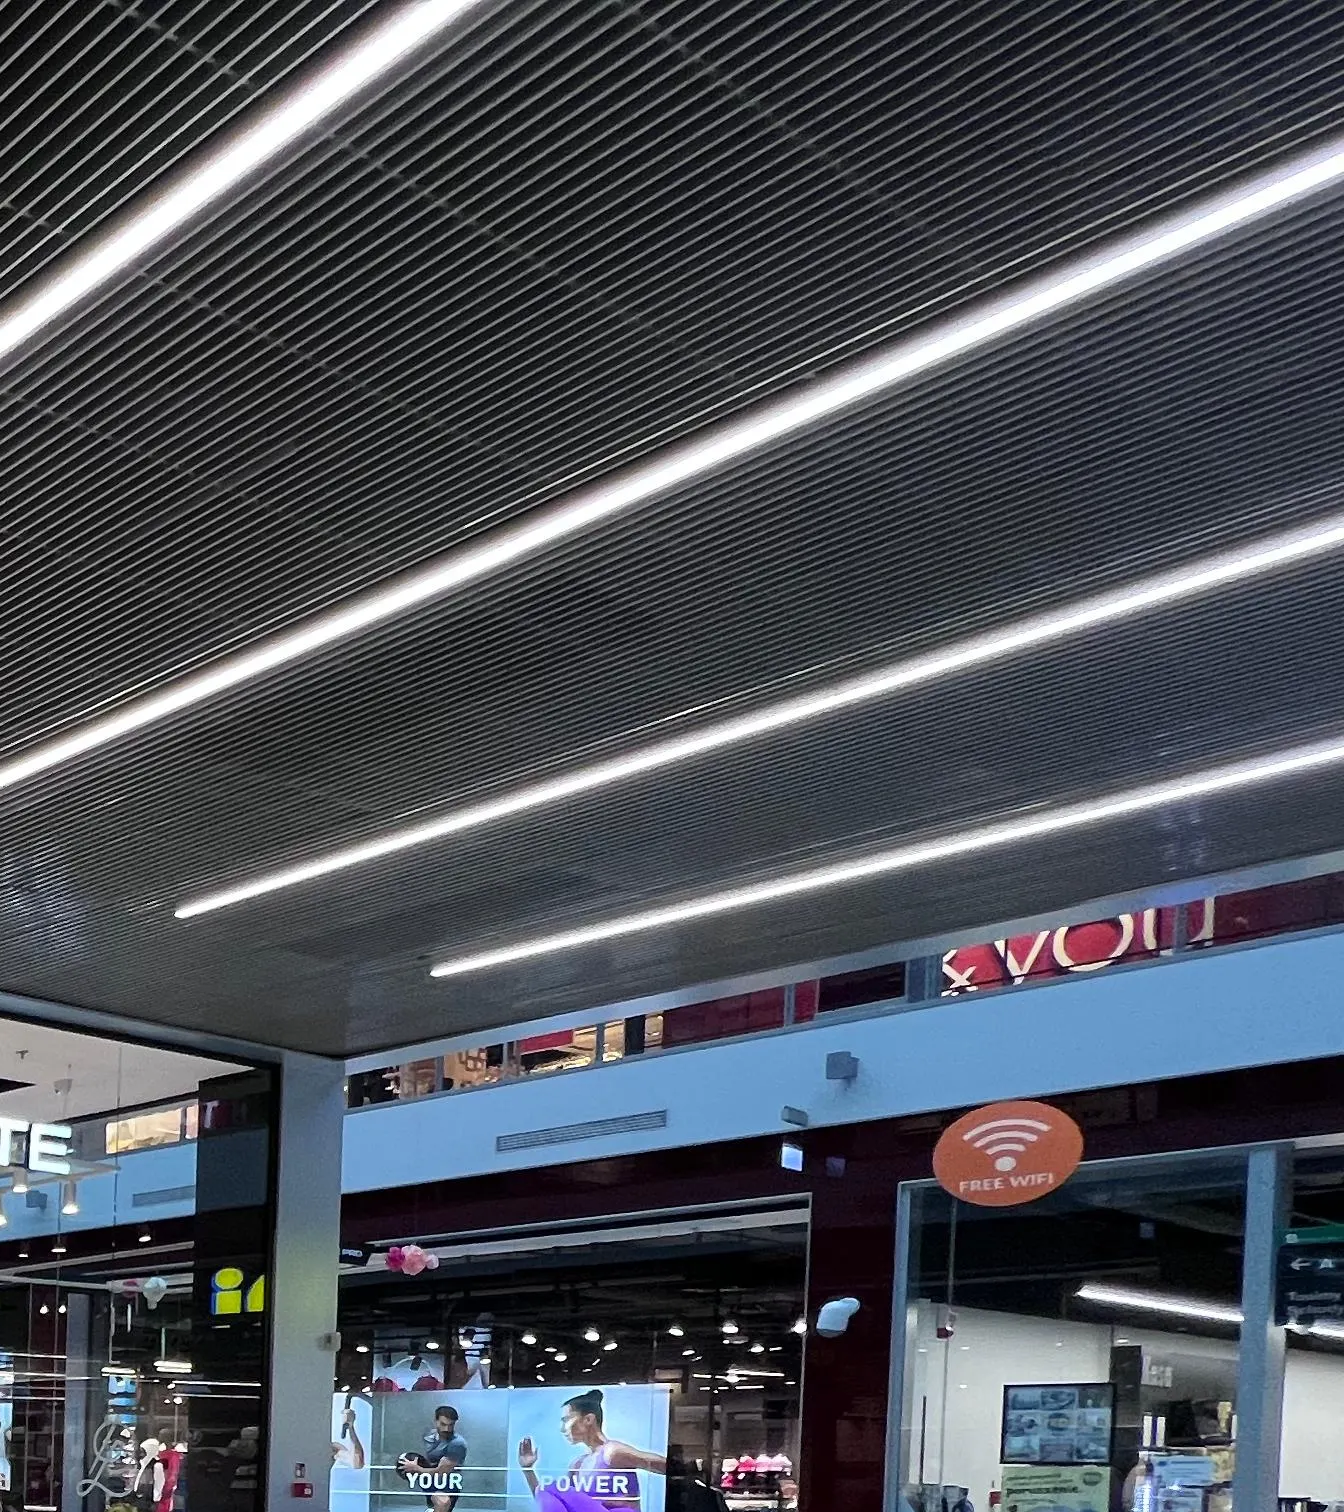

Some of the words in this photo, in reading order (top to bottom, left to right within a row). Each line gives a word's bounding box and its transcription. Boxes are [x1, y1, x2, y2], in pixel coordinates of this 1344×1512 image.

[959, 1177, 1004, 1193] FREE
[1010, 1172, 1055, 1188] WIFI
[405, 1472, 463, 1490] YOUR
[539, 1475, 629, 1494] POWER
